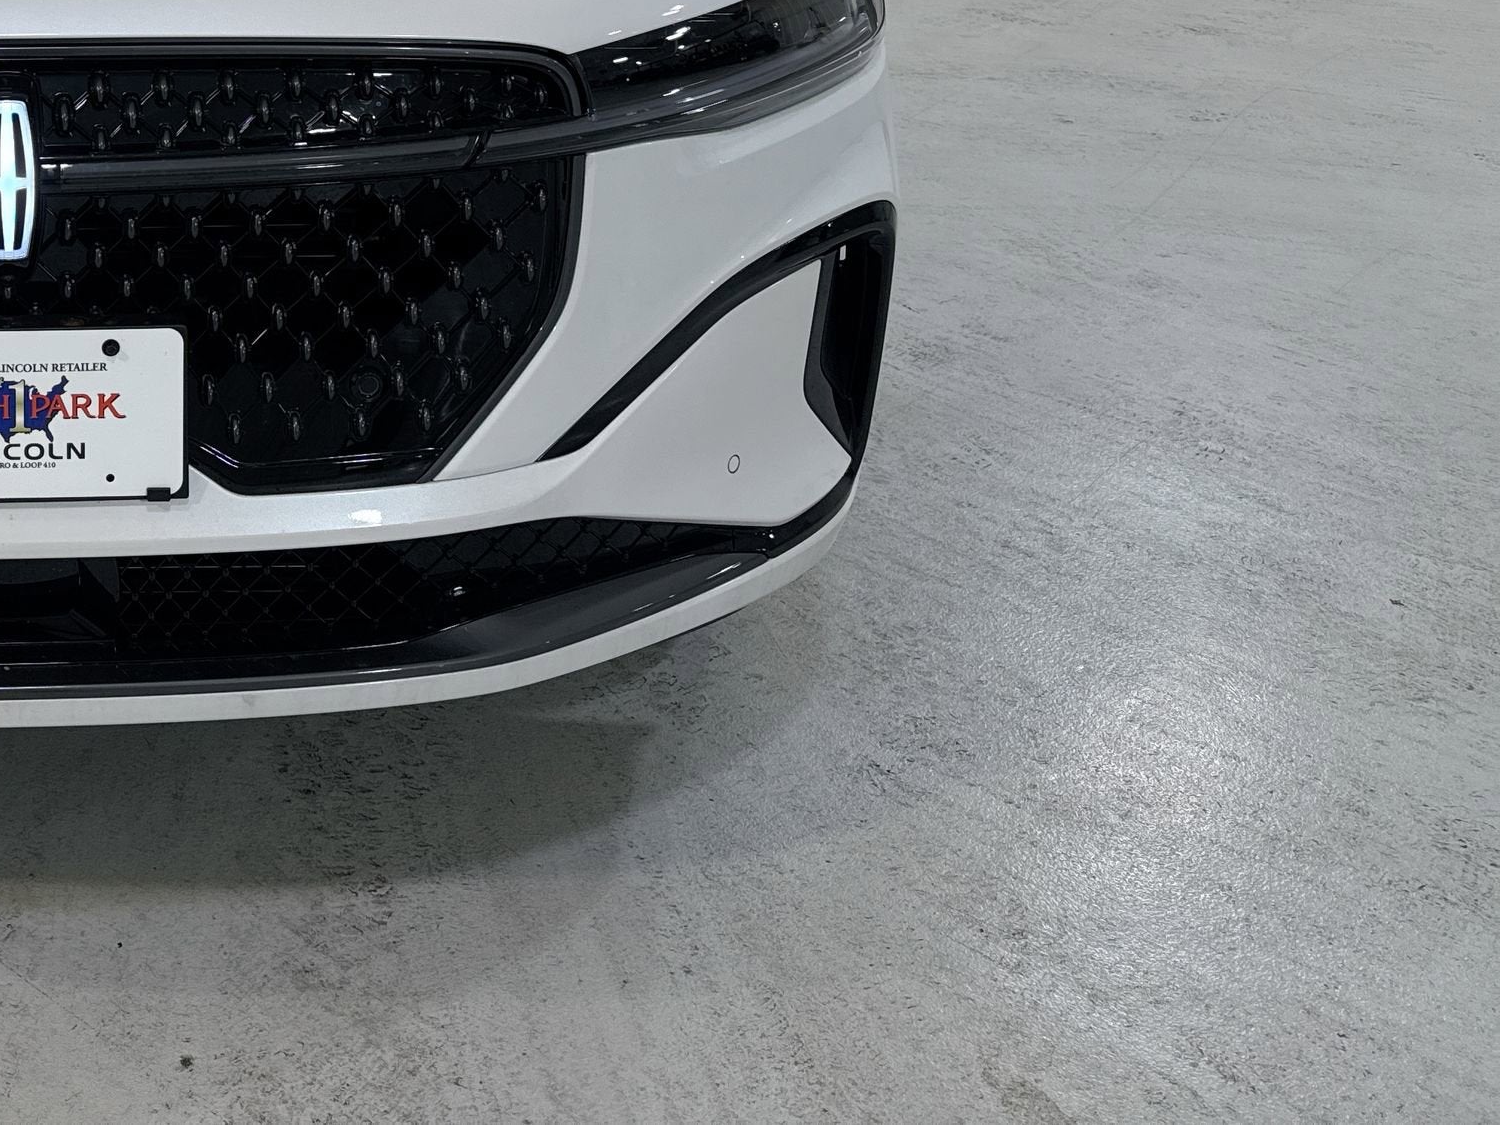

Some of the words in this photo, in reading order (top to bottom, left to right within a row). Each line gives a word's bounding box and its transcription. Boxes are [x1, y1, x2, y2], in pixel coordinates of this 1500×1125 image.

[51, 361, 109, 373] RETAILER
[30, 392, 127, 420] PARK
[20, 461, 43, 469] LOOP
